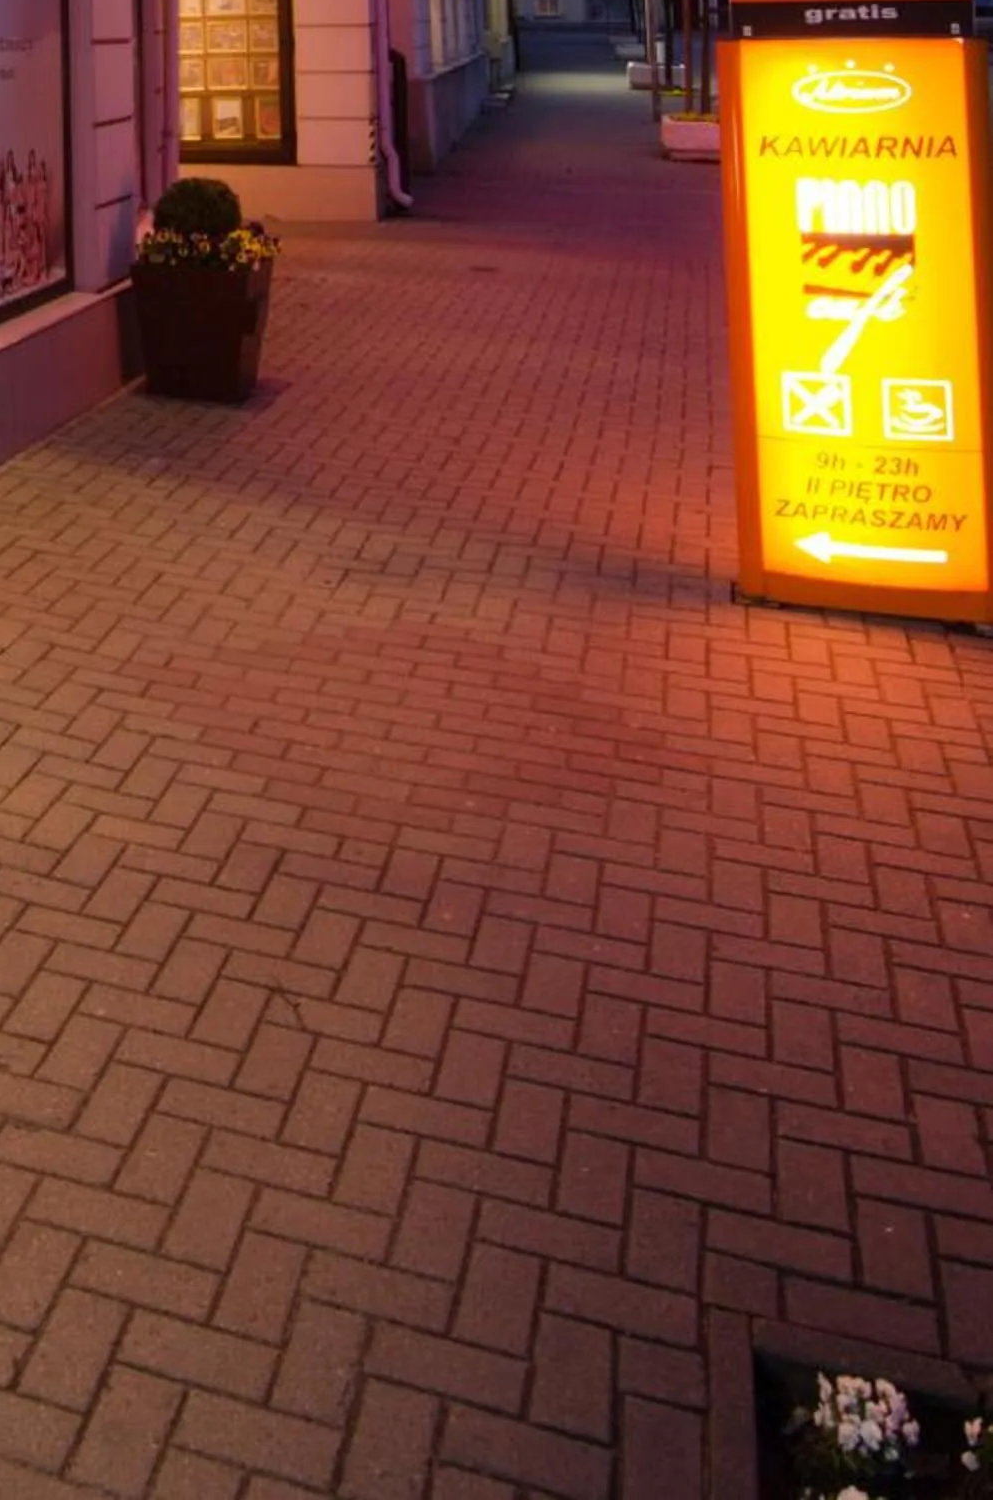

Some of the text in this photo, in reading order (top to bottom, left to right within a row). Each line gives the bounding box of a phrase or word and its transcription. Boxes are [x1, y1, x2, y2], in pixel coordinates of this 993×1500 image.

[803, 3, 899, 24] gratis
[758, 134, 958, 160] KAWIARNIA
[816, 451, 846, 472] 9h
[873, 455, 921, 477] 23h
[830, 479, 933, 504] PIĘTRO
[774, 499, 969, 532] ZAPRASZAMY
